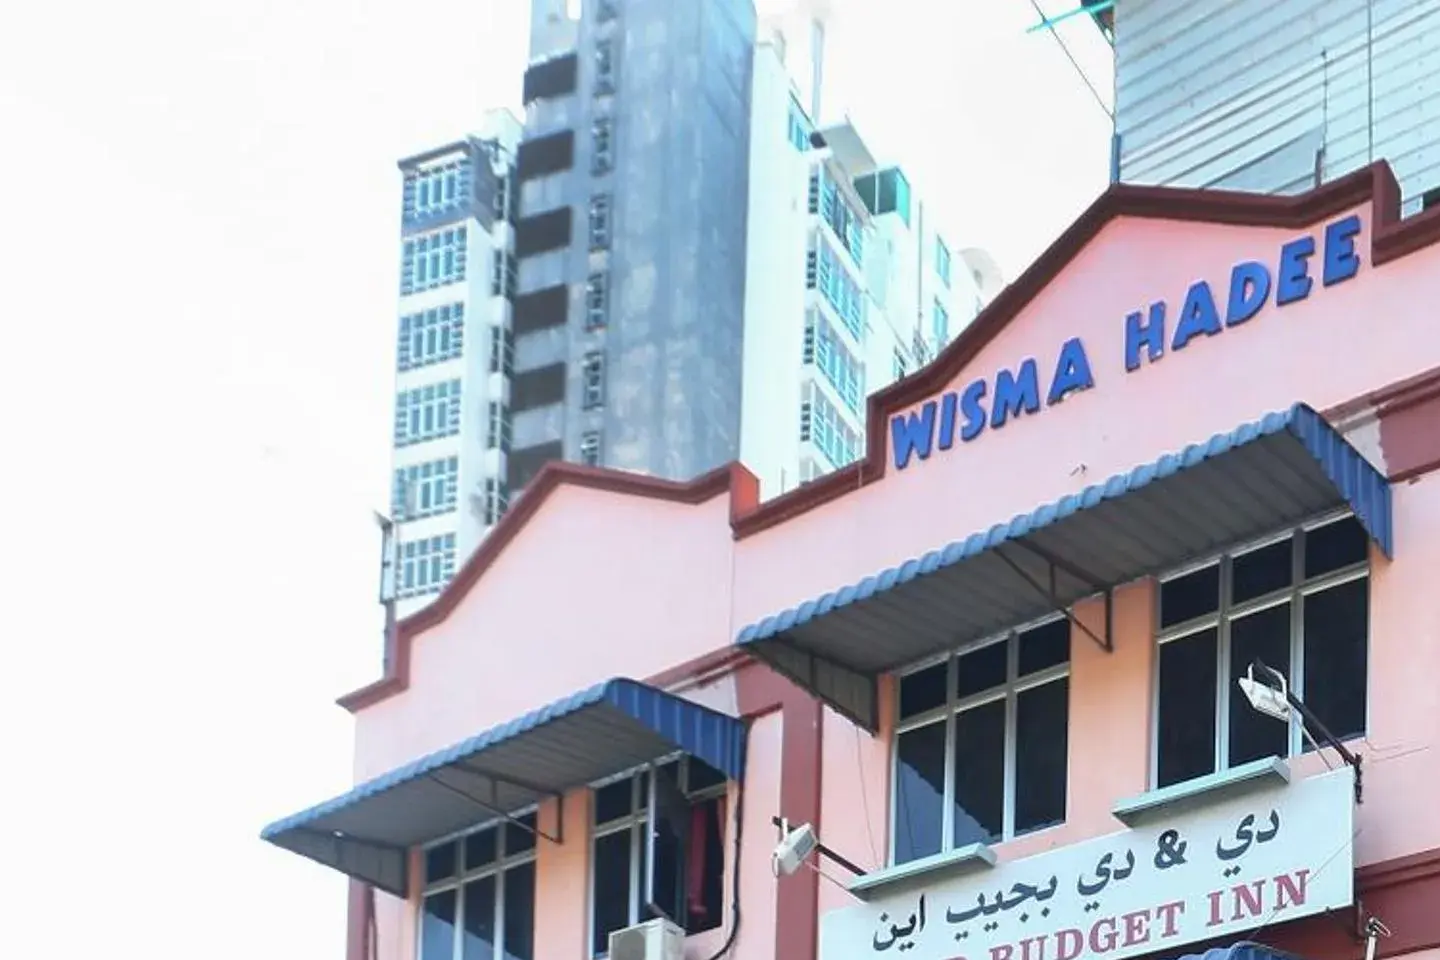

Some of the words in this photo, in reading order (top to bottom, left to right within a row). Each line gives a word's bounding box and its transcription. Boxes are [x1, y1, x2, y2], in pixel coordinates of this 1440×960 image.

[890, 337, 1095, 470] WISMA
[1124, 214, 1362, 372] HADEE
[1153, 829, 1188, 869] &
[1206, 868, 1313, 928] INN
